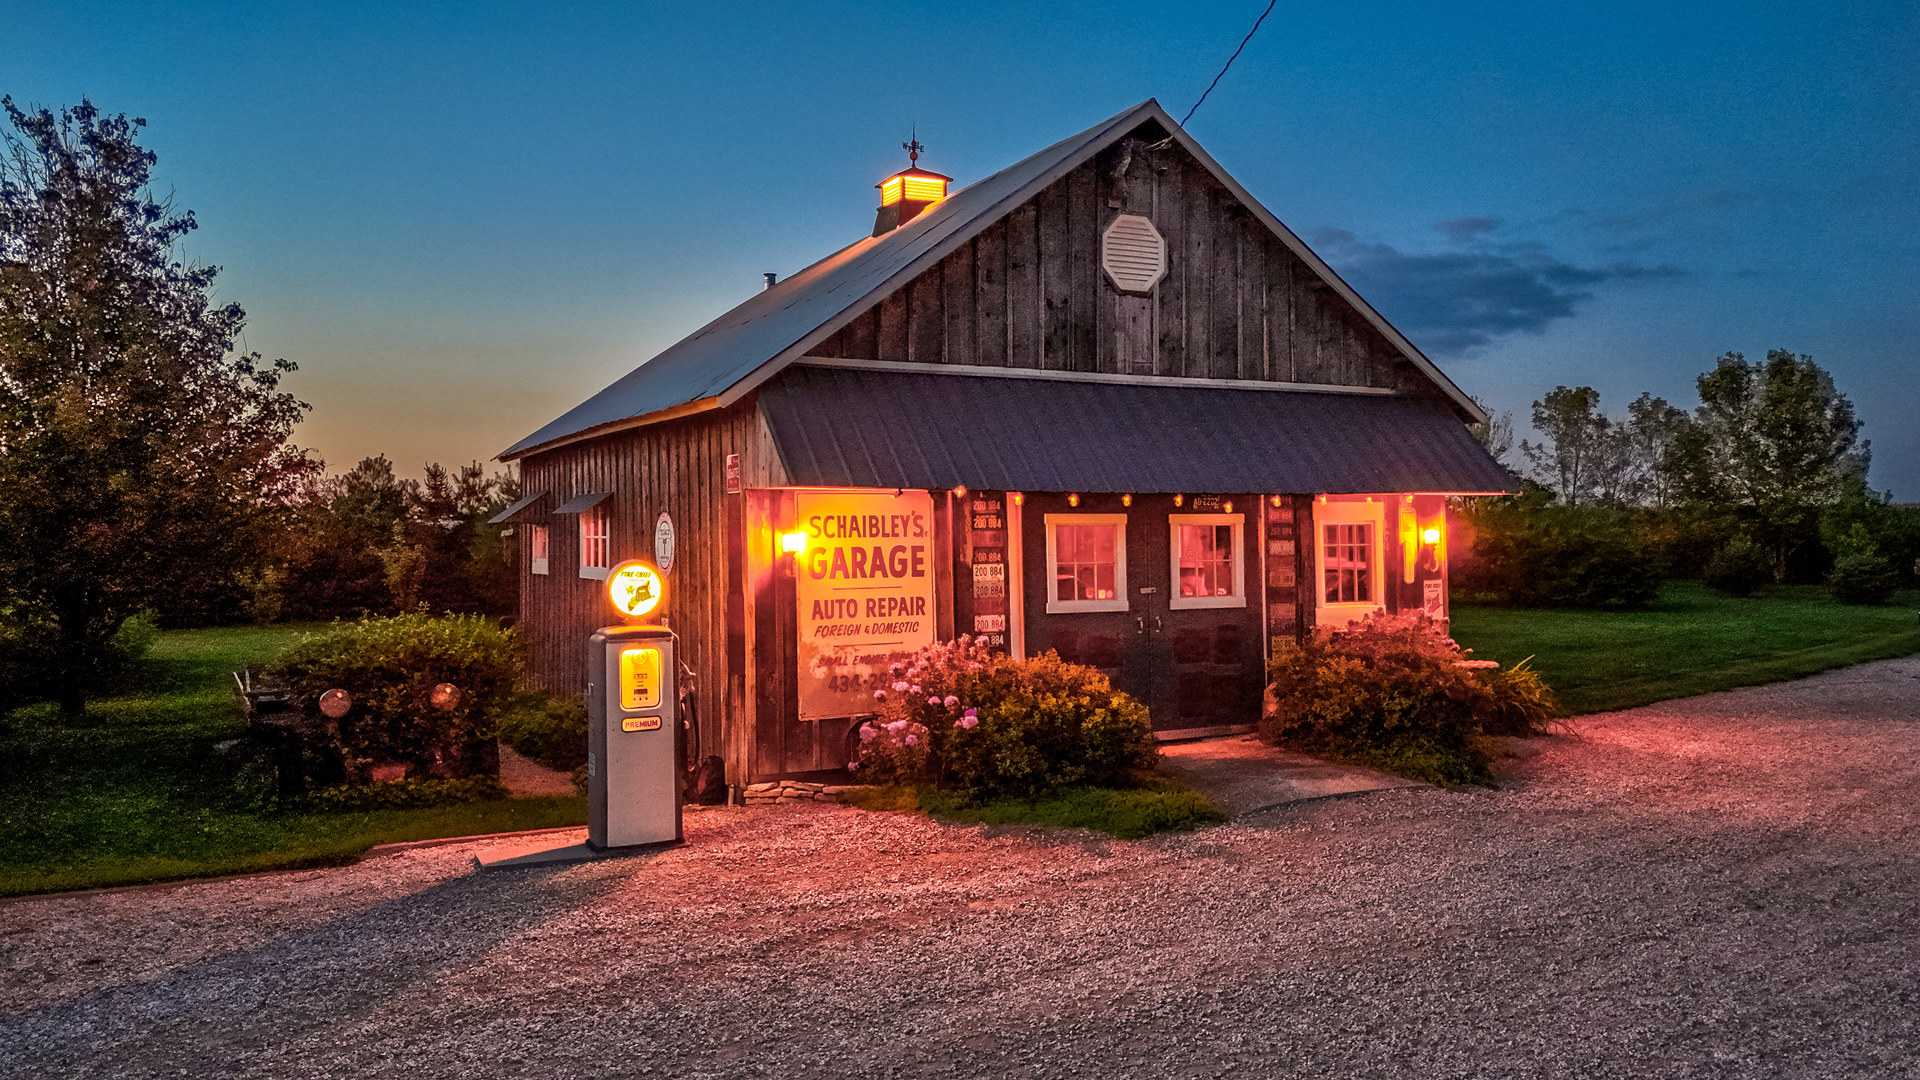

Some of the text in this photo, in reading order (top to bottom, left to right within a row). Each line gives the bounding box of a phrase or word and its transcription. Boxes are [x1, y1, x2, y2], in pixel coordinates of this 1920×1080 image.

[808, 510, 925, 539] SCHAIBLEY'S
[974, 518, 1002, 529] 200 884
[808, 545, 925, 580] GARAGE
[974, 566, 1003, 577] 200 884
[975, 585, 1003, 597] 200 884
[811, 596, 926, 620] AUTO REPAIR
[814, 621, 920, 638] FOREIGN & DOMESTIC
[976, 620, 989, 630] 200
[990, 634, 1004, 645] 884
[817, 656, 848, 668] SMALL
[852, 654, 887, 666] ENGINE
[625, 719, 659, 729] PREMIUM
